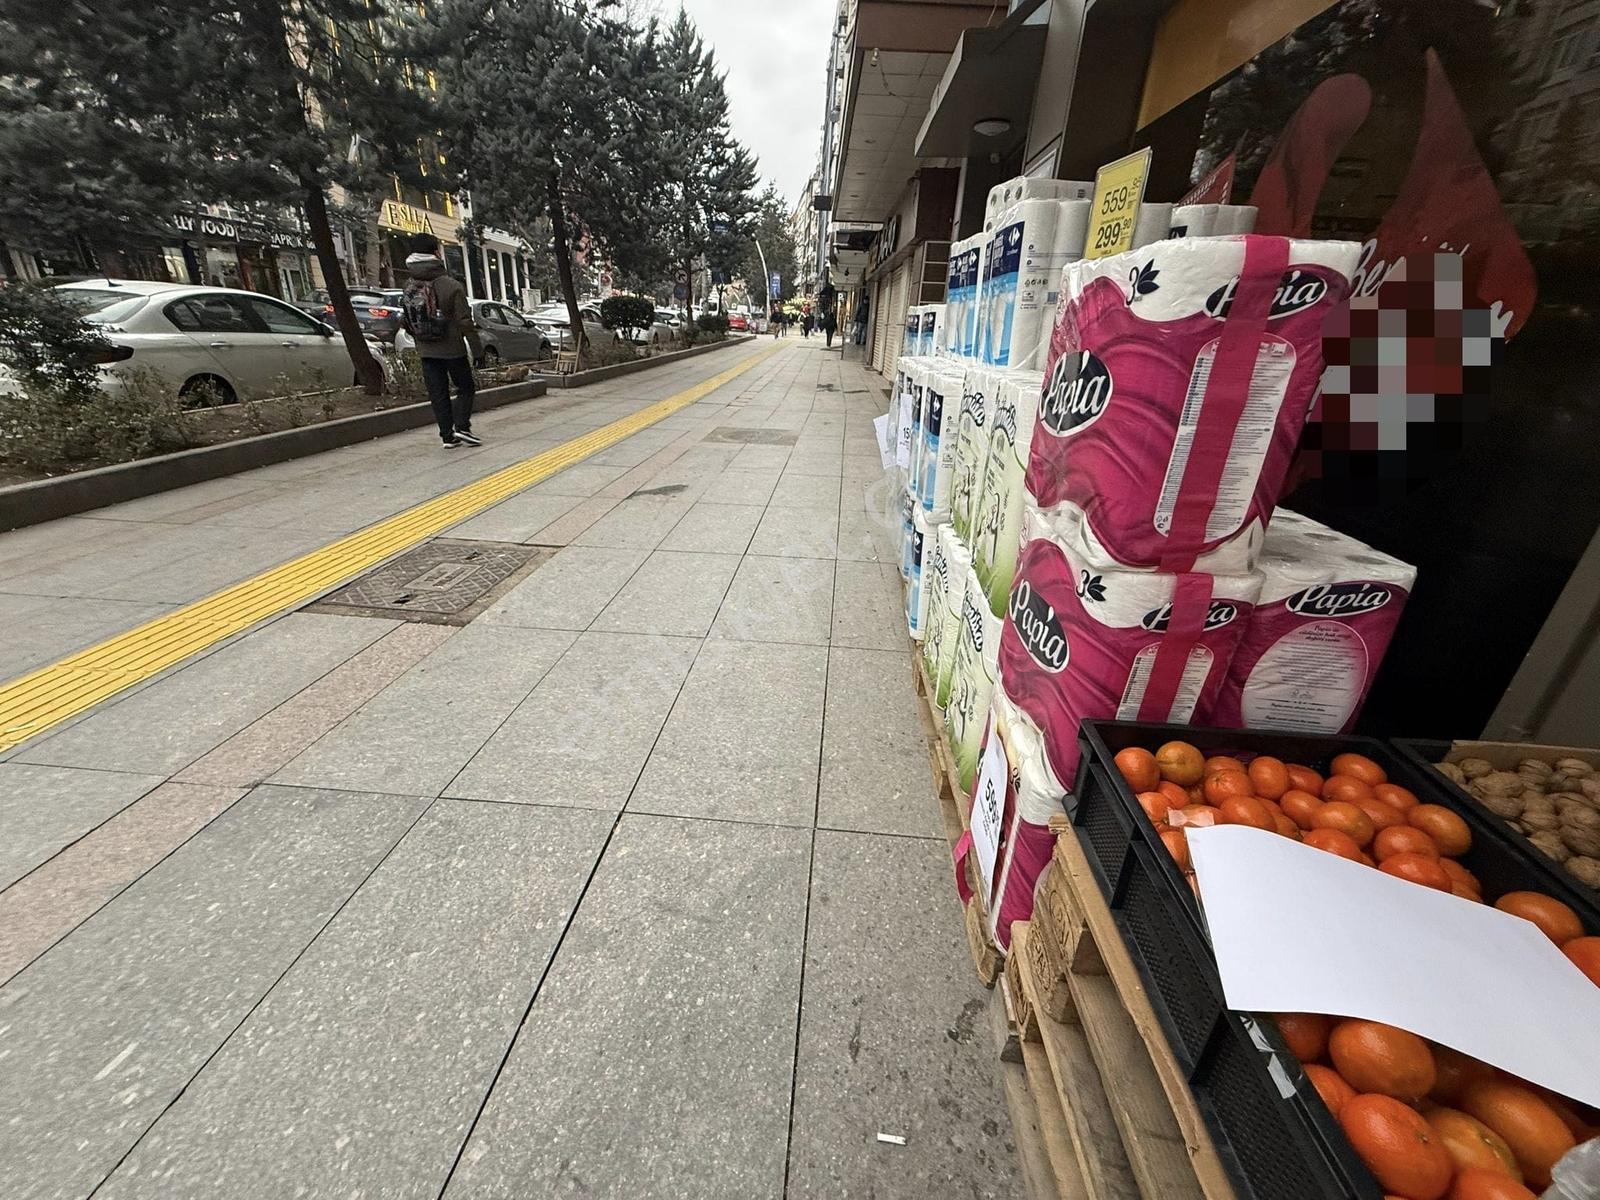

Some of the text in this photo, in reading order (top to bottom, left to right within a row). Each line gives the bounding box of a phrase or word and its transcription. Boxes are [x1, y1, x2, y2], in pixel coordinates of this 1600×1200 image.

[1101, 186, 1127, 215] 559
[1095, 222, 1121, 249] 299
[1040, 350, 1107, 434] Papia
[1293, 583, 1386, 616] Papia
[1009, 578, 1064, 666] Papia
